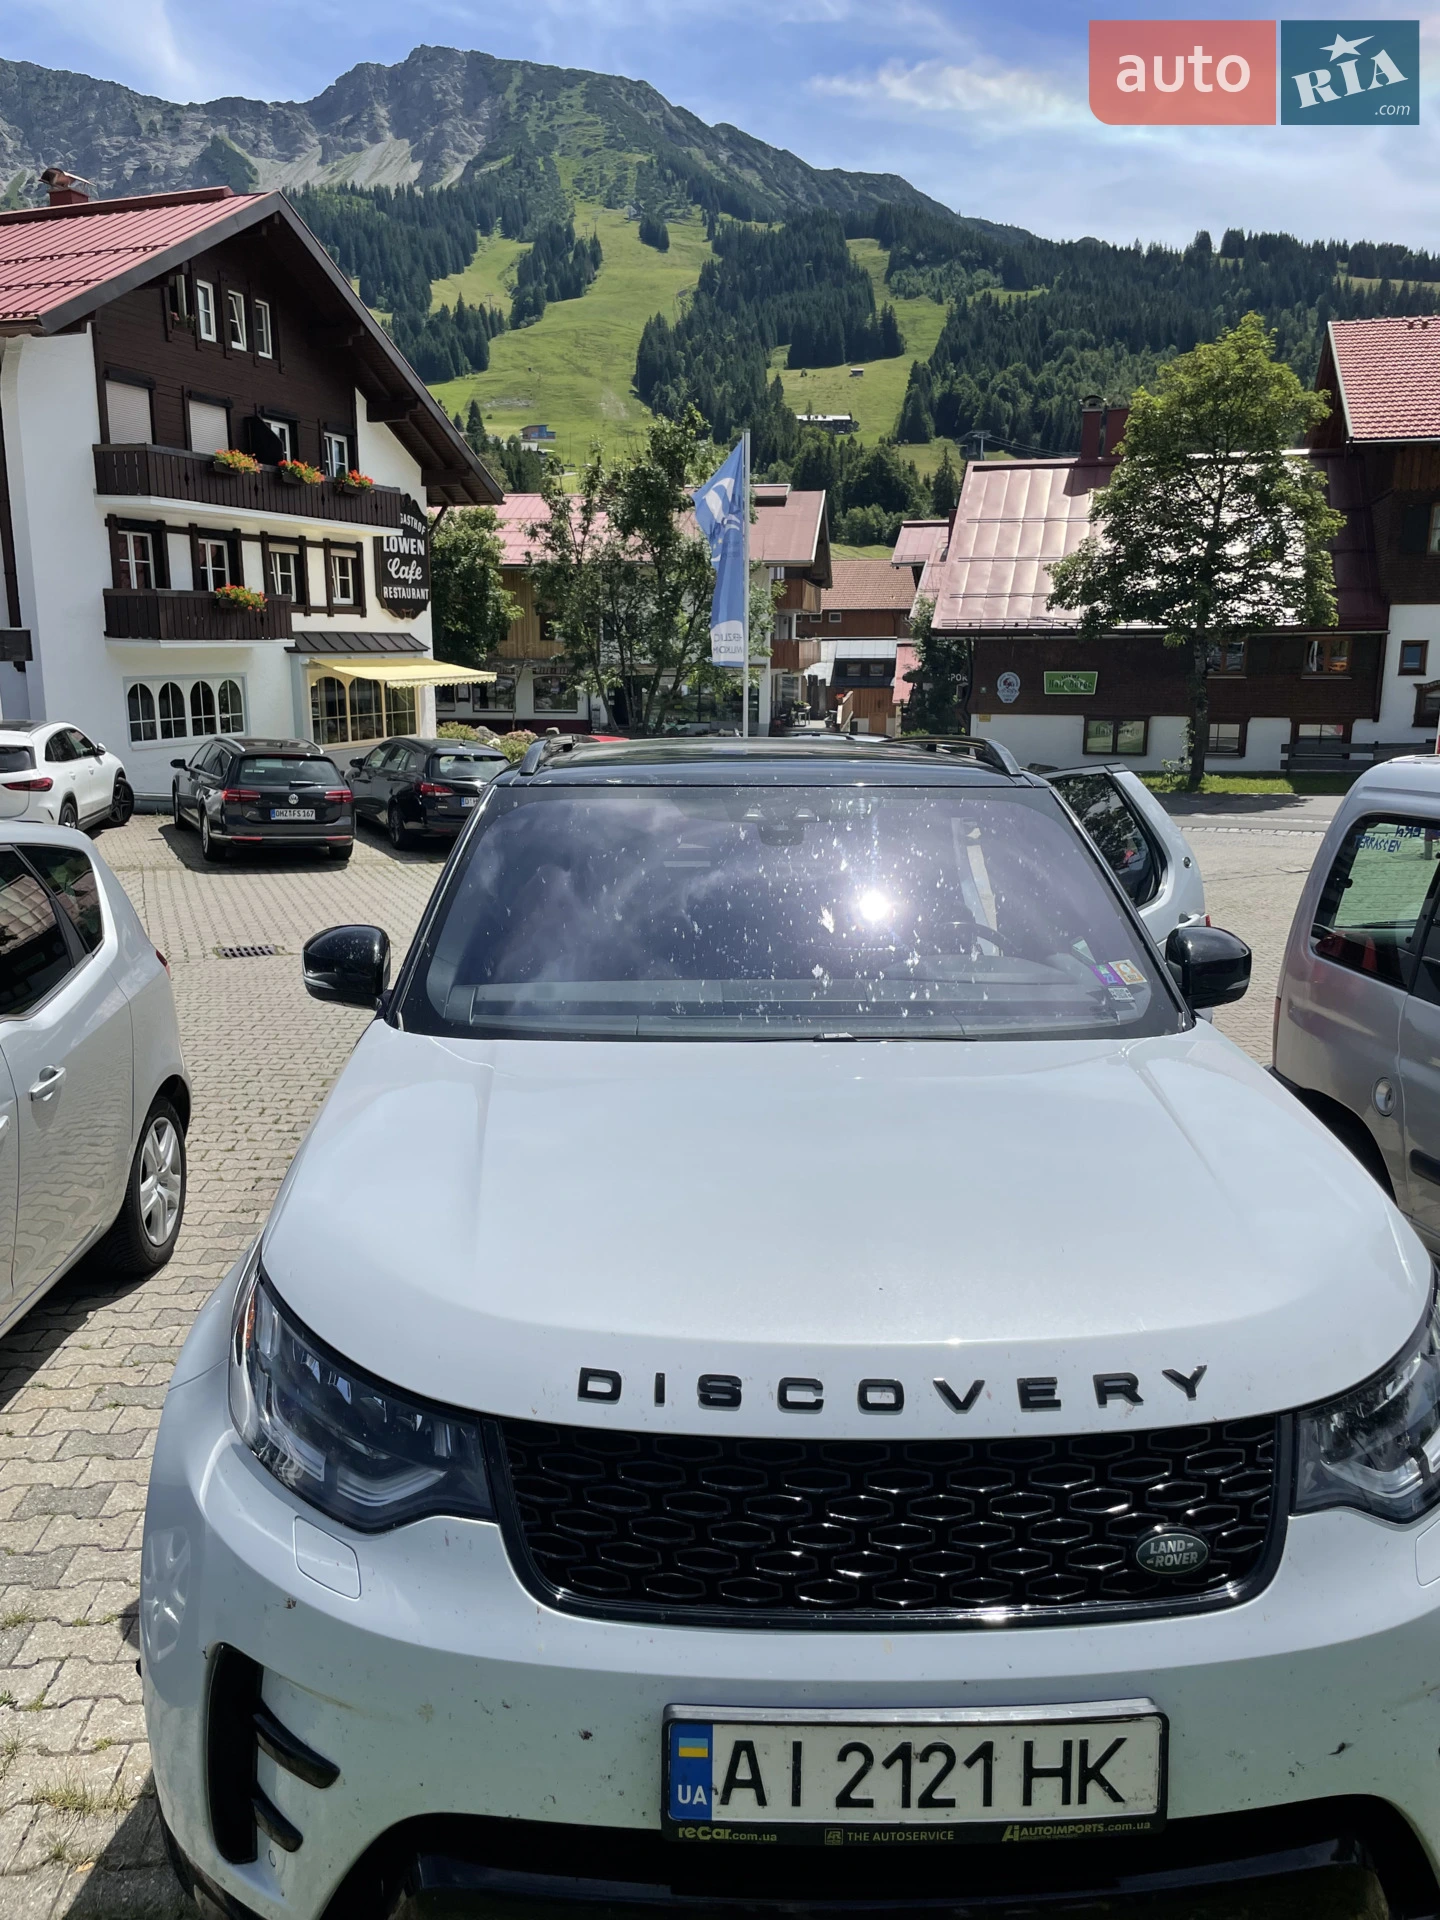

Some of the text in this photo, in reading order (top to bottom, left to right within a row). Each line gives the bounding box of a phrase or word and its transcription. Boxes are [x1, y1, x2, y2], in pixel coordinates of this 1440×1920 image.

[387, 557, 423, 585] Cafe
[383, 586, 430, 600] RESTAURANT
[302, 809, 315, 818] 167
[577, 1365, 1208, 1414] DISCOVERY
[1150, 1540, 1186, 1555] LAND
[1155, 1551, 1199, 1567] ROVER
[719, 1737, 1128, 1809] AI 2121 HK
[677, 1784, 708, 1806] UA
[847, 1831, 870, 1841] THE
[872, 1830, 955, 1841] AUTOSERVICE
